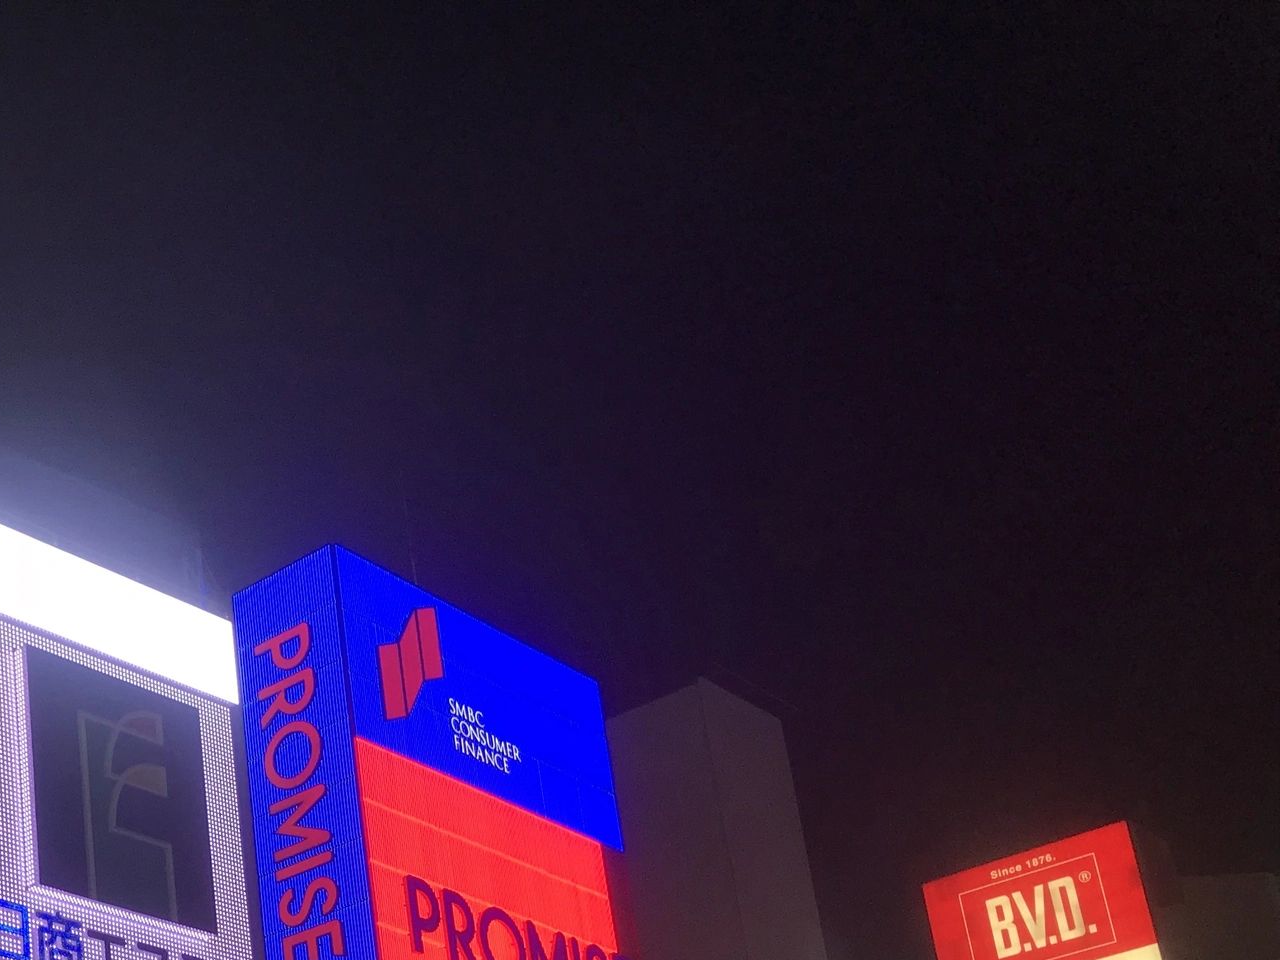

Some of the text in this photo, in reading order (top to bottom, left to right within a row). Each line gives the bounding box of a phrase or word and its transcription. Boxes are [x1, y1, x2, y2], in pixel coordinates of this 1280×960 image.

[448, 697, 484, 728] SMBC
[450, 717, 522, 764] CONSUMER
[454, 734, 510, 775] FINANCE
[990, 865, 1022, 880] Since
[985, 876, 1098, 960] B.V.D.
